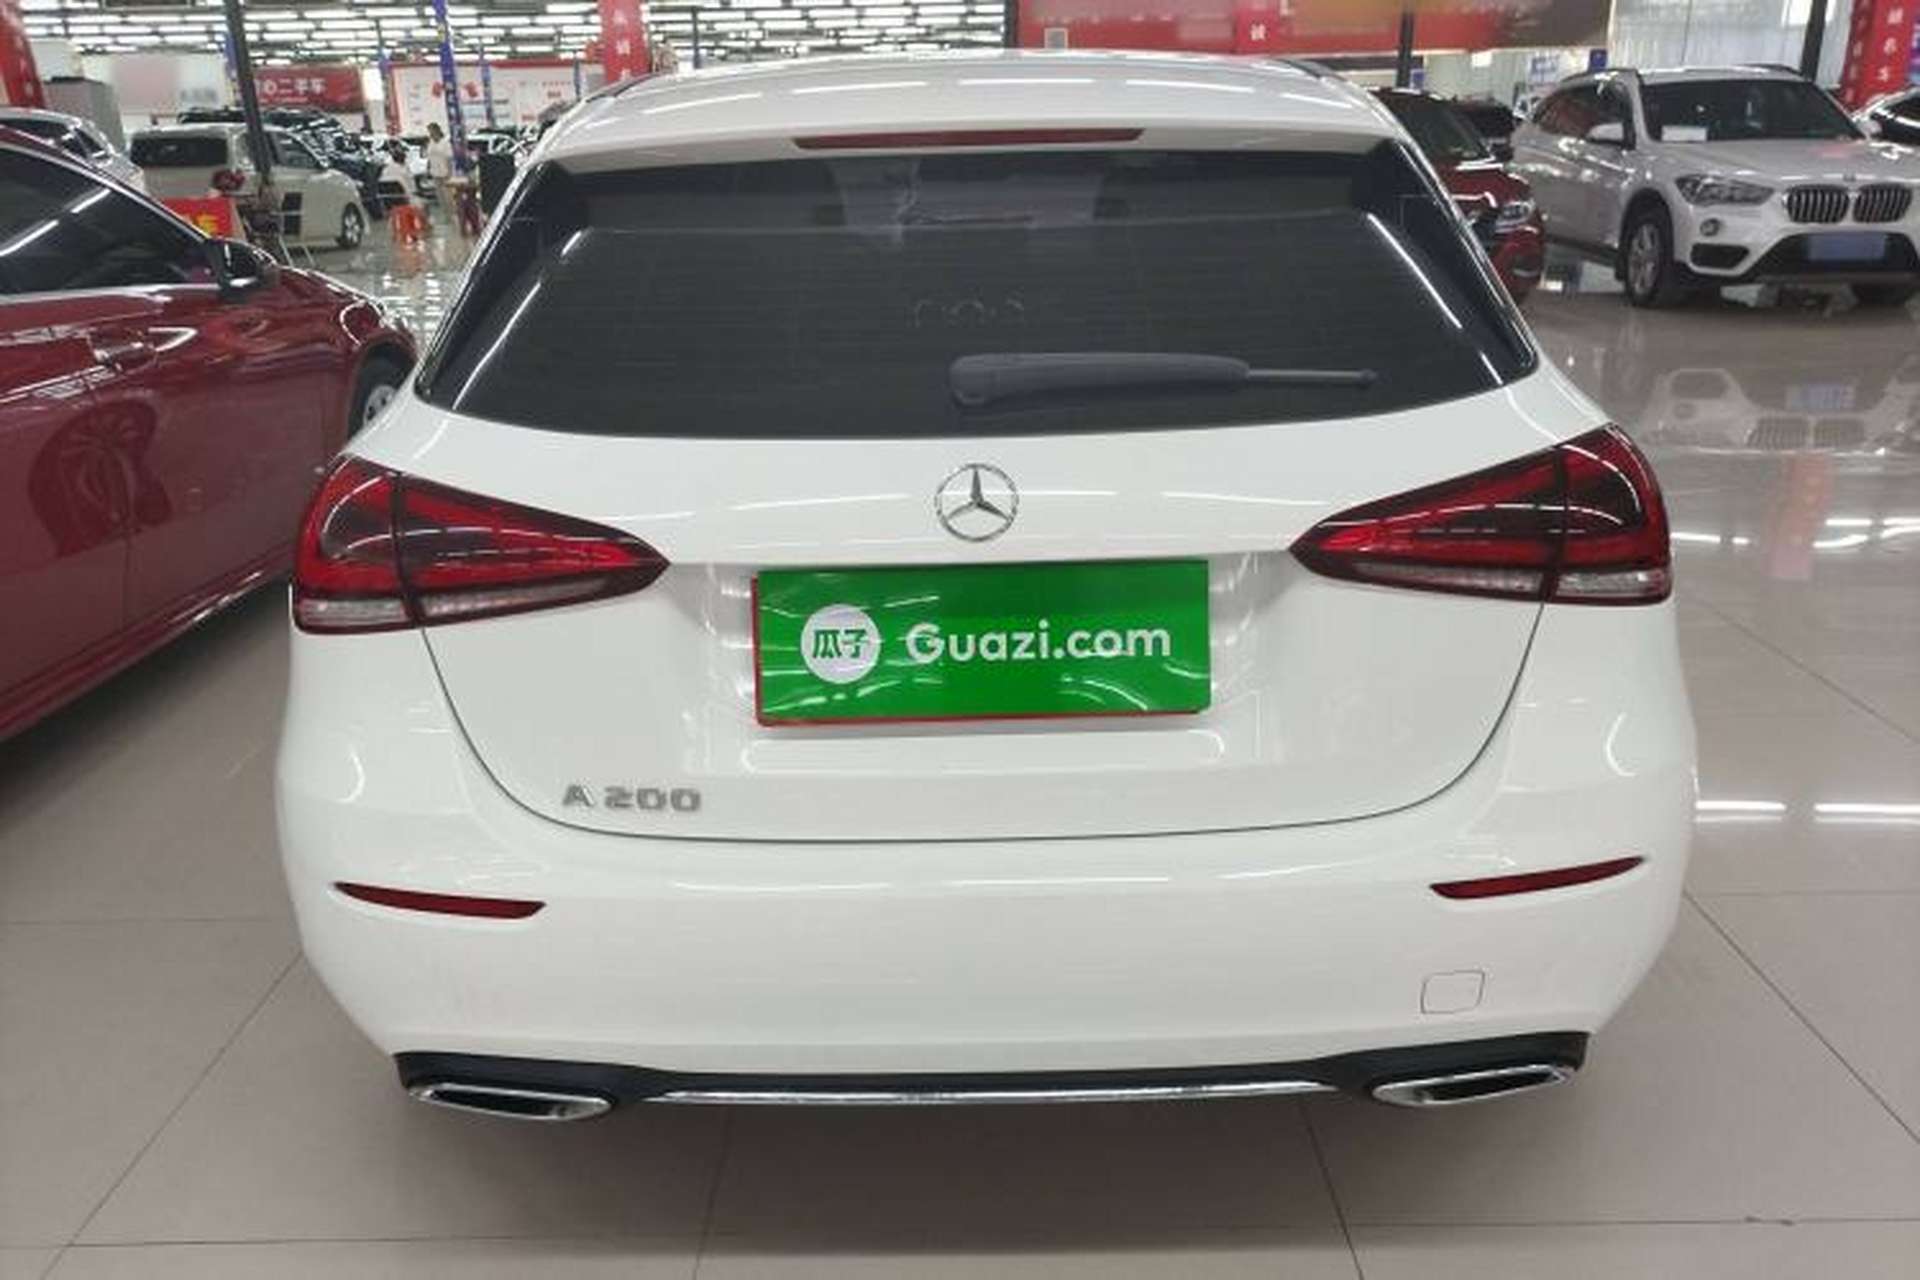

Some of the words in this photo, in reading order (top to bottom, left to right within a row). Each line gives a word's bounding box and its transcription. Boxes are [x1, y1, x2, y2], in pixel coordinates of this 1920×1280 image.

[812, 628, 869, 660] 瓜子
[905, 620, 1172, 665] Guazi.com
[562, 784, 595, 807] A
[604, 786, 701, 812] 200
